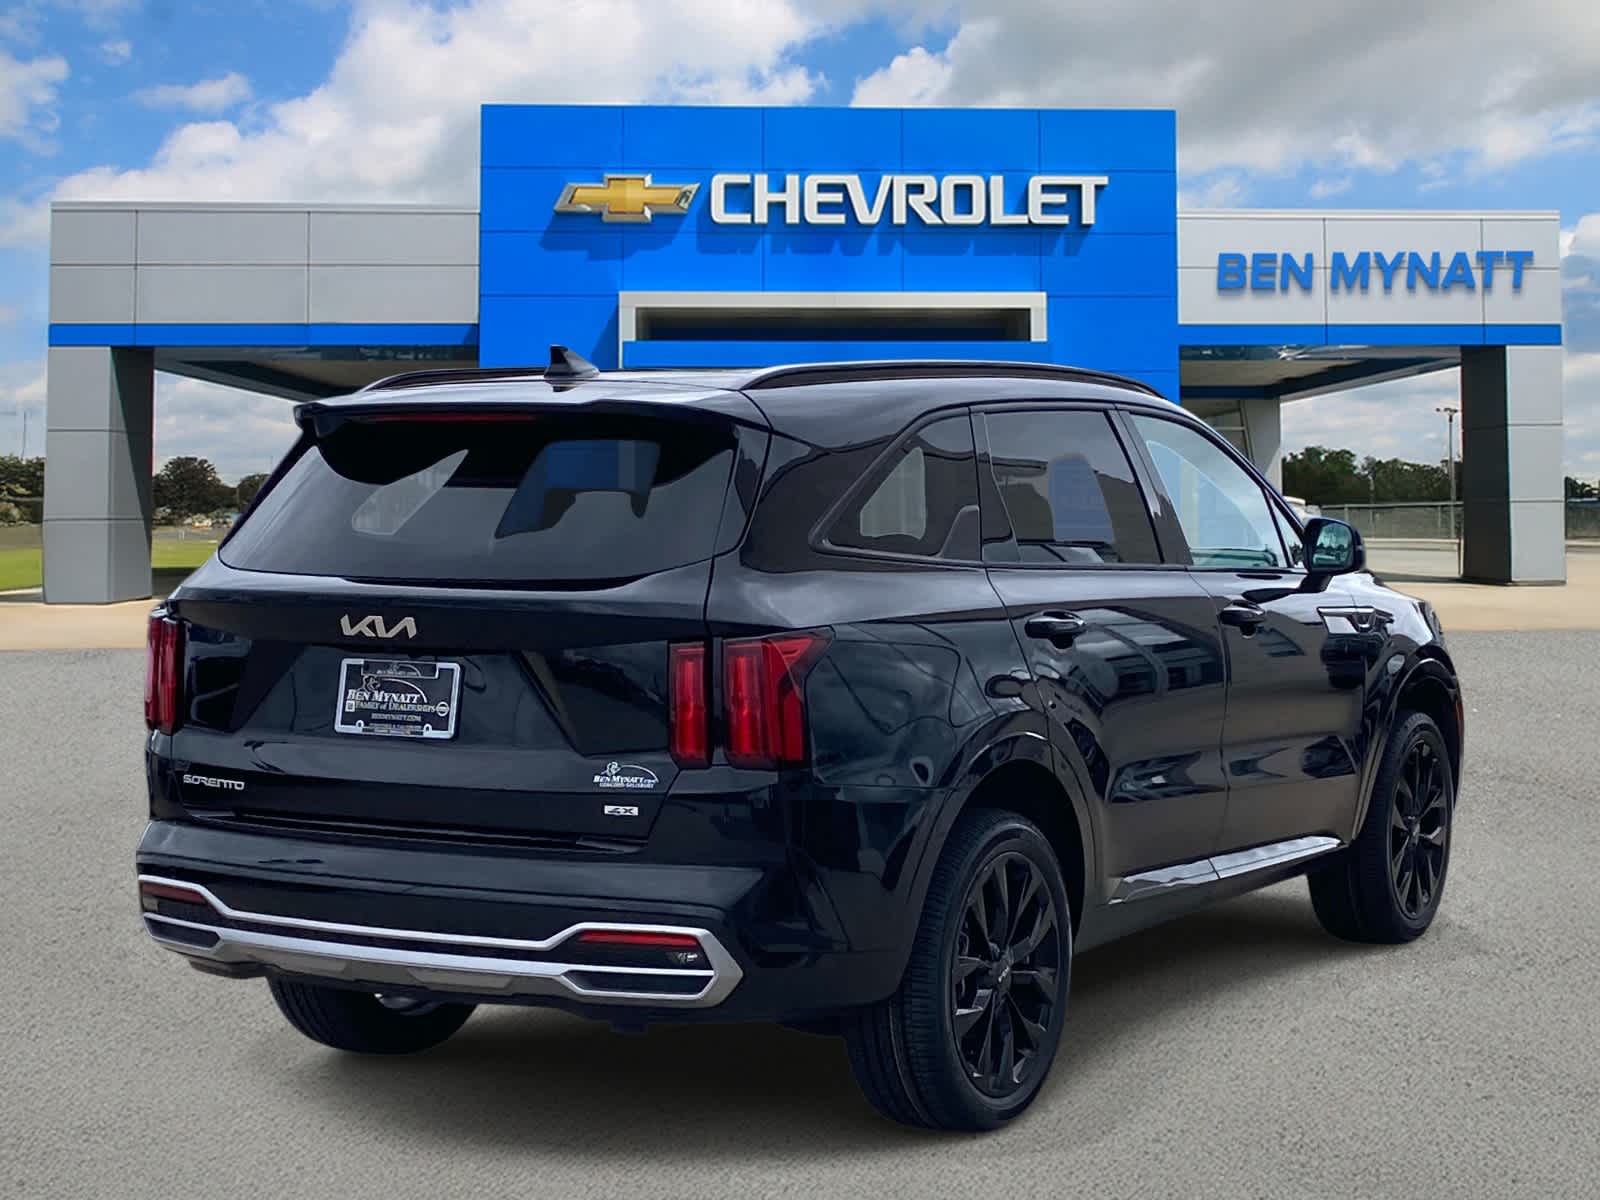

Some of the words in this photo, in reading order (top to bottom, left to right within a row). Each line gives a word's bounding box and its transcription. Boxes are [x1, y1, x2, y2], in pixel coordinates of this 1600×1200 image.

[710, 173, 1109, 226] CHEVROLET
[1217, 252, 1314, 290] BEN
[1330, 250, 1535, 290] MYNATT
[340, 614, 417, 639] KIA
[346, 689, 371, 701] BEN
[371, 690, 421, 704] MYNATT
[183, 774, 245, 790] SORENTO
